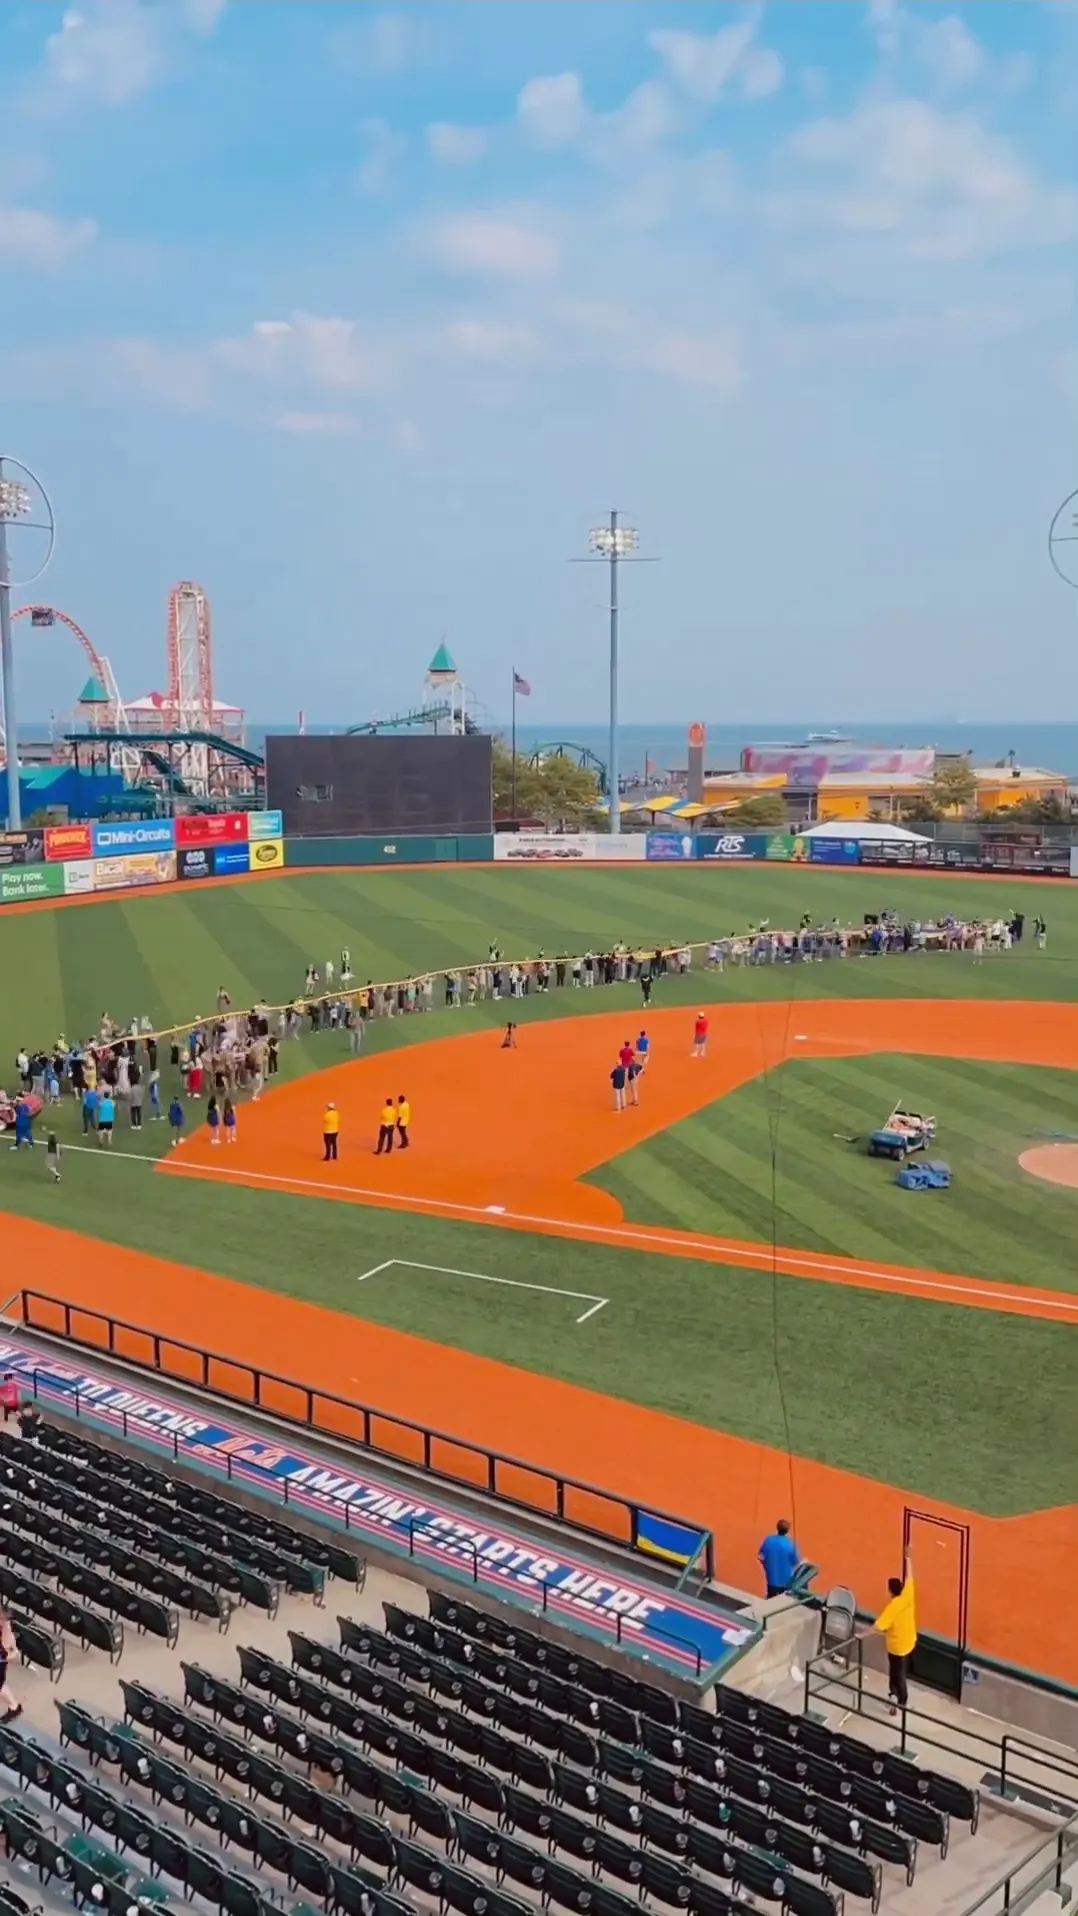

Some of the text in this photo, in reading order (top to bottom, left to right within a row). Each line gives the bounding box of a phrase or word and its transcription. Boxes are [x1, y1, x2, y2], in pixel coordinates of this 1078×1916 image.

[112, 828, 170, 845] Mini-Circuits
[715, 835, 745, 853] RTS
[2, 871, 44, 885] Play now.
[3, 884, 25, 896] Bank
[62, 1377, 209, 1441] TO QUEENS
[277, 1465, 665, 1629] AMAZIN' STARTS HERE
